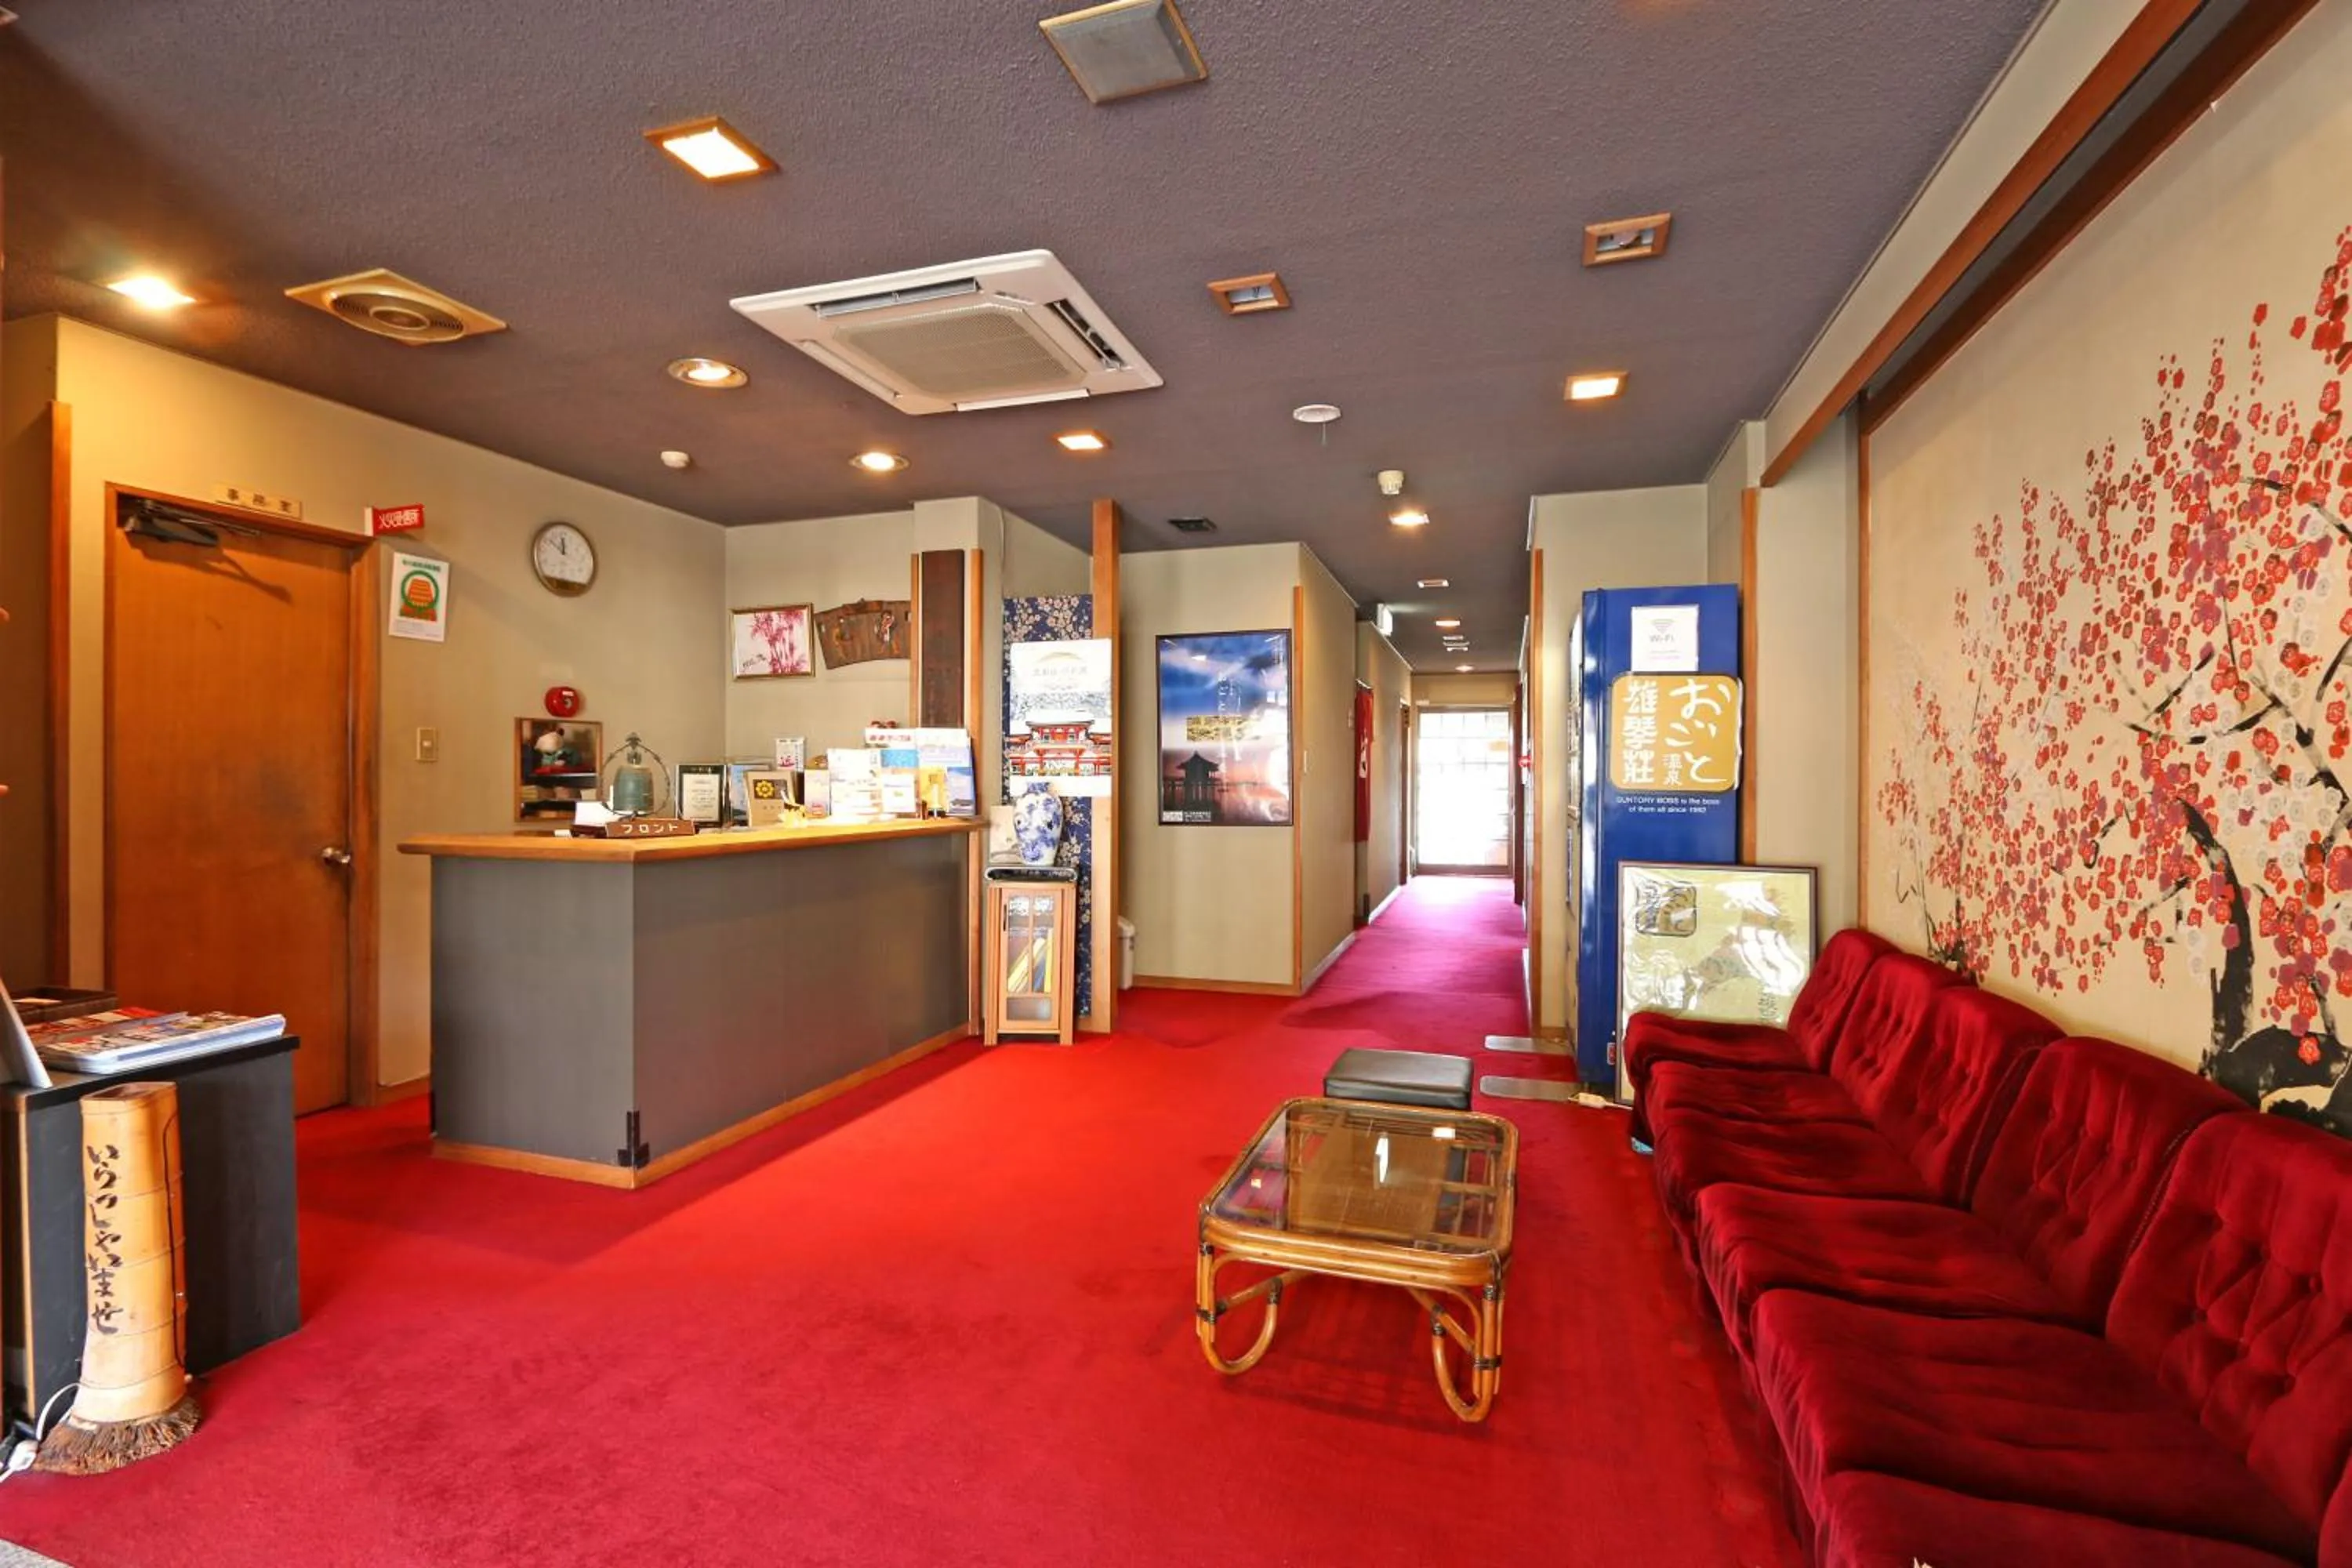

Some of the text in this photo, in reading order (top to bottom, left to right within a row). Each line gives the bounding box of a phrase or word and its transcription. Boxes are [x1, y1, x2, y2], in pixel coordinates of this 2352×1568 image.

[622, 824, 678, 833] フロント
[87, 1145, 123, 1334] いらっしゃいませ
